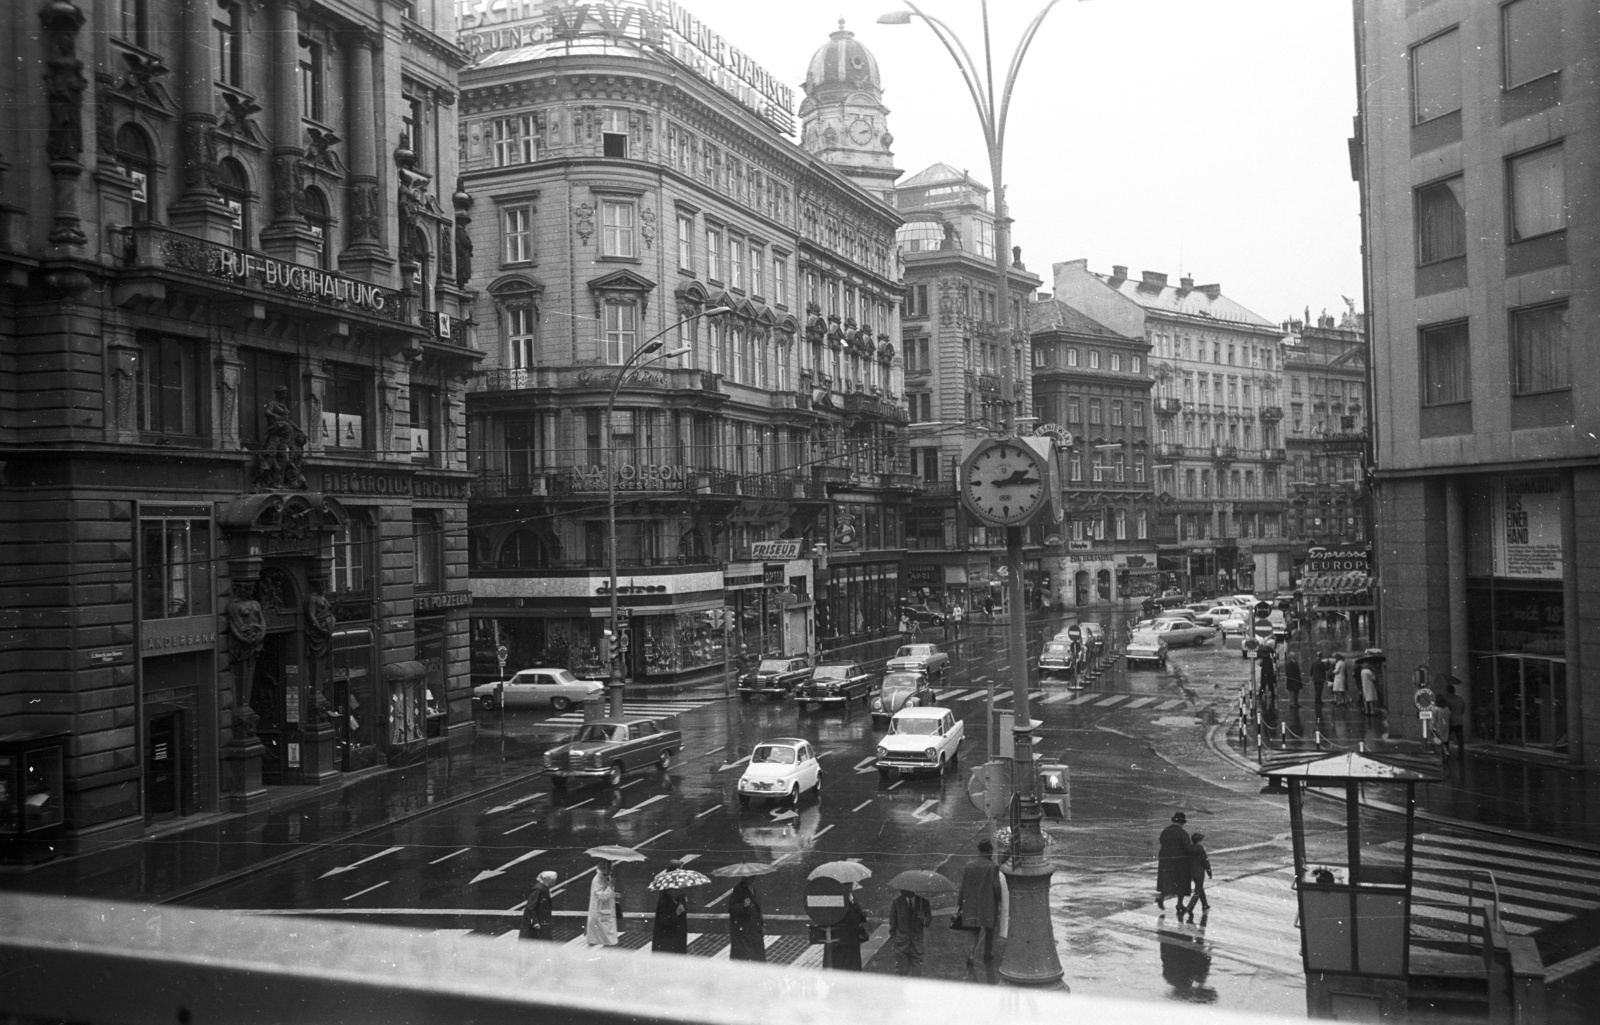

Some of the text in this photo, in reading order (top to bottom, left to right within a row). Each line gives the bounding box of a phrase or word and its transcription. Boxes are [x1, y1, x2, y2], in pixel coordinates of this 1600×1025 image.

[456, 23, 546, 55] RUNG
[221, 249, 384, 310] RUF-BUCHHALTUNG
[1506, 495, 1521, 511] AUS
[1506, 511, 1528, 528] EINER
[1507, 528, 1528, 544] HAND
[753, 544, 797, 556] FRISEUR
